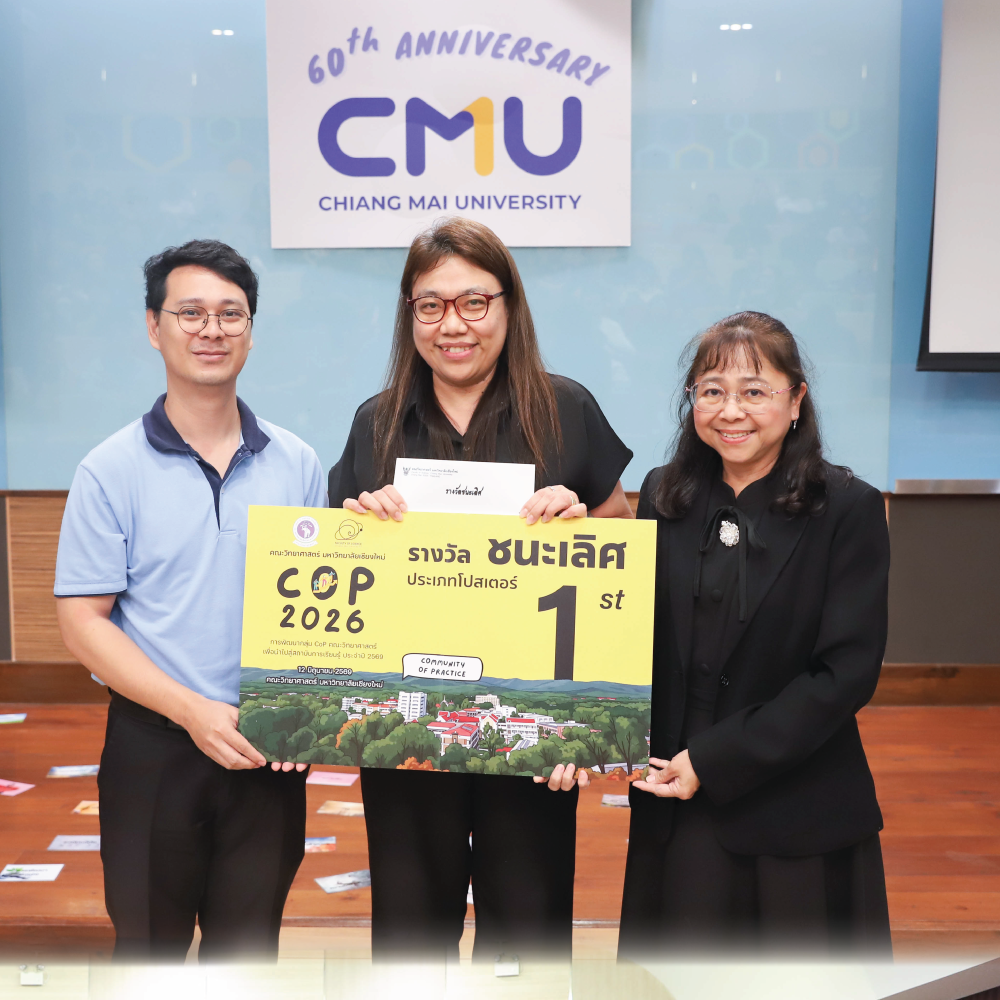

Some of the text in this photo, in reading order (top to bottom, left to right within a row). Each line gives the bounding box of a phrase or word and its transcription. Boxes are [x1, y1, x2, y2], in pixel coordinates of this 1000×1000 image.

[308, 26, 611, 86] 60th ANNIVERSARY
[318, 96, 582, 177] CMU
[319, 194, 582, 211] CHIANG MAI UNIVERSITY
[269, 550, 386, 560] คณะวิทยาศาสตร์ มหาวิทยาลัยเชียงใหม่
[408, 534, 627, 570] รางวัล ชนะเลิศ
[277, 566, 375, 605] COP
[407, 572, 518, 590] ประเภทโปสเตอร์
[280, 604, 364, 634] 2026
[538, 585, 625, 681] 1 st
[329, 641, 377, 649] คณะวิทยาศาสตร์
[334, 667, 353, 675] 2569
[420, 657, 466, 668] COMMUNITY
[430, 668, 466, 677] PRACTICE
[266, 676, 384, 688] คณะวิทยาศาสตร์ มหาวิทยาลัยเชียงใหม่
